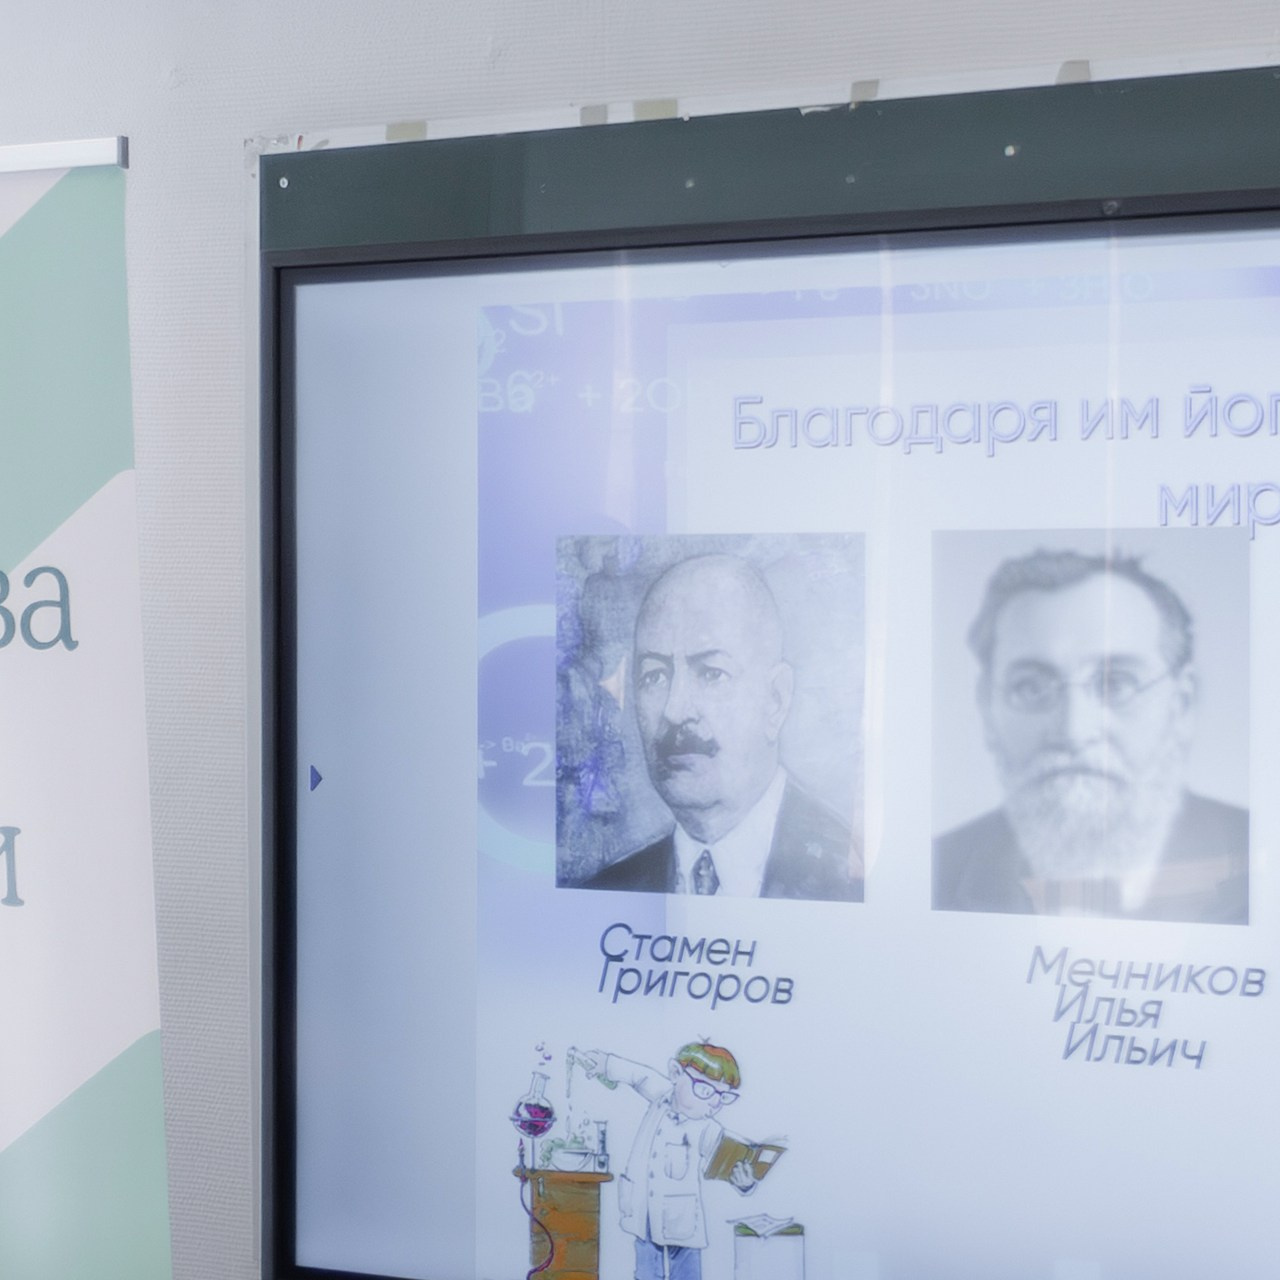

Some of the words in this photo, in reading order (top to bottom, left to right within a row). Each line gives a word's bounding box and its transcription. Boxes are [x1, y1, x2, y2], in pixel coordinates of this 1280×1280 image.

[732, 396, 1058, 458] Благодаря
[1080, 395, 1160, 441] им
[600, 922, 757, 967] Стамен
[598, 956, 794, 1011] Григоров
[1026, 945, 1267, 997] Мечников
[1052, 982, 1164, 1030] Илья
[1062, 1021, 1208, 1070] Ильич
